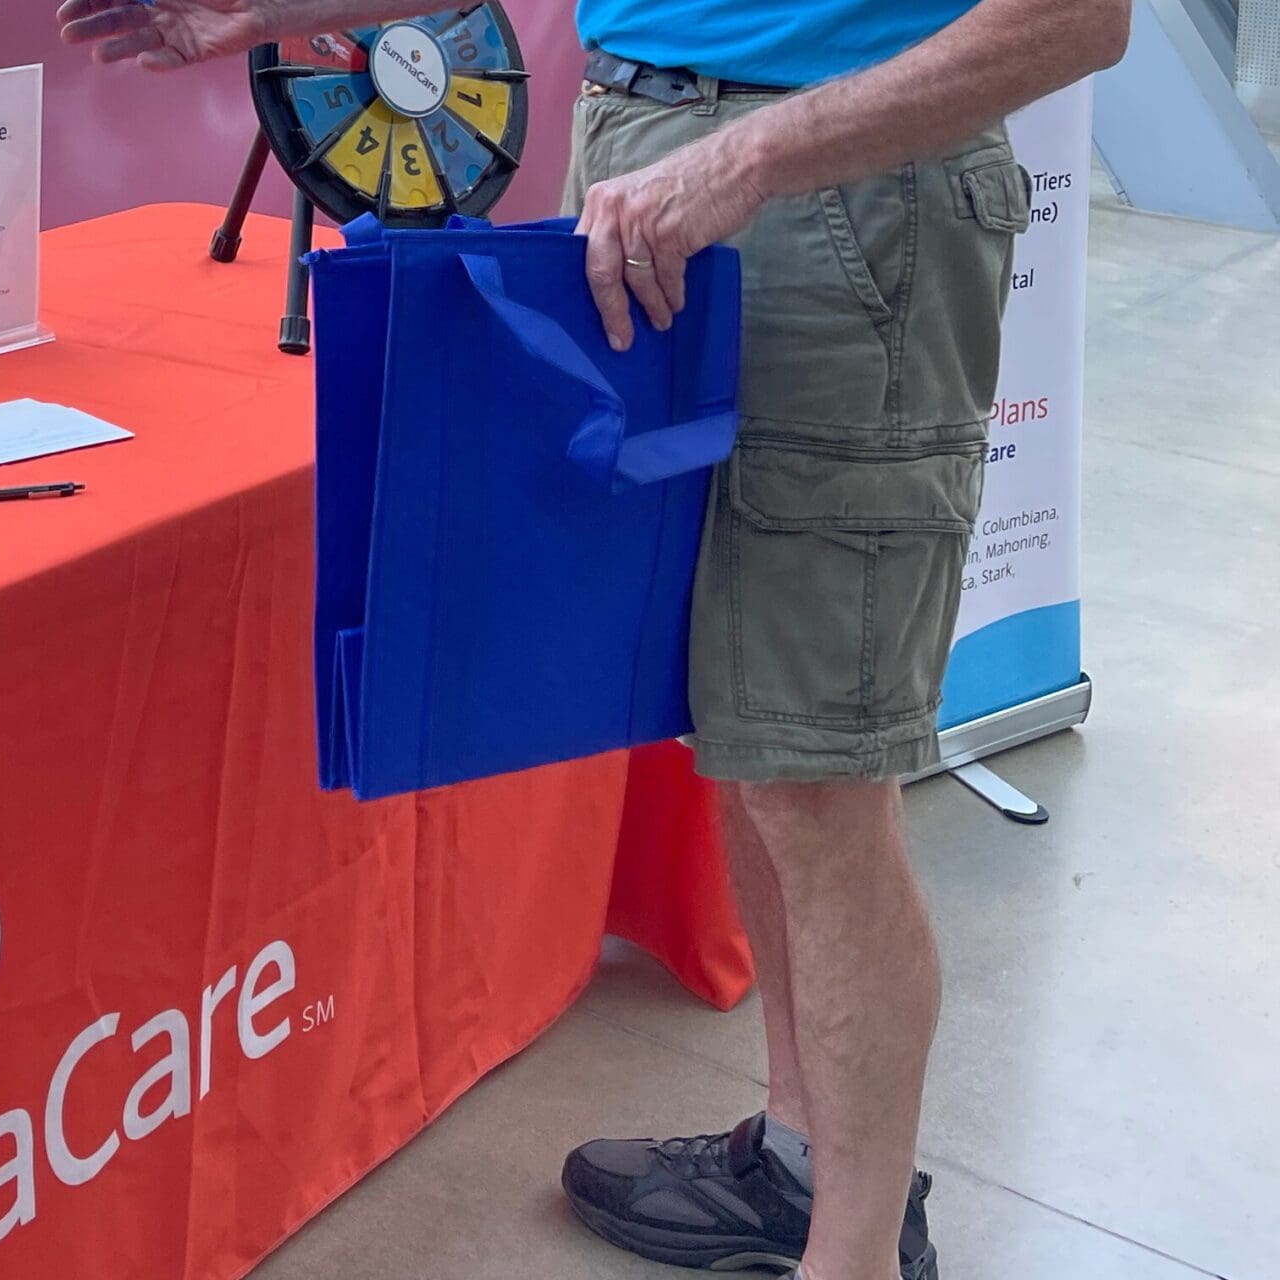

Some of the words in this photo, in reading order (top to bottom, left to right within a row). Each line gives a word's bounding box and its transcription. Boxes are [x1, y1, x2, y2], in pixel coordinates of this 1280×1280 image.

[380, 40, 439, 95] SummaCare
[323, 84, 354, 110] 5
[457, 90, 483, 108] 1
[355, 126, 380, 156] 4
[431, 120, 460, 153] 2
[400, 143, 422, 176] 3
[1033, 172, 1072, 192] Tiers
[984, 444, 1016, 464] are
[983, 508, 1060, 536] Columbiana,
[986, 533, 1051, 559] Mahoning,
[982, 563, 1016, 585] Stark,
[302, 995, 336, 1033] SM
